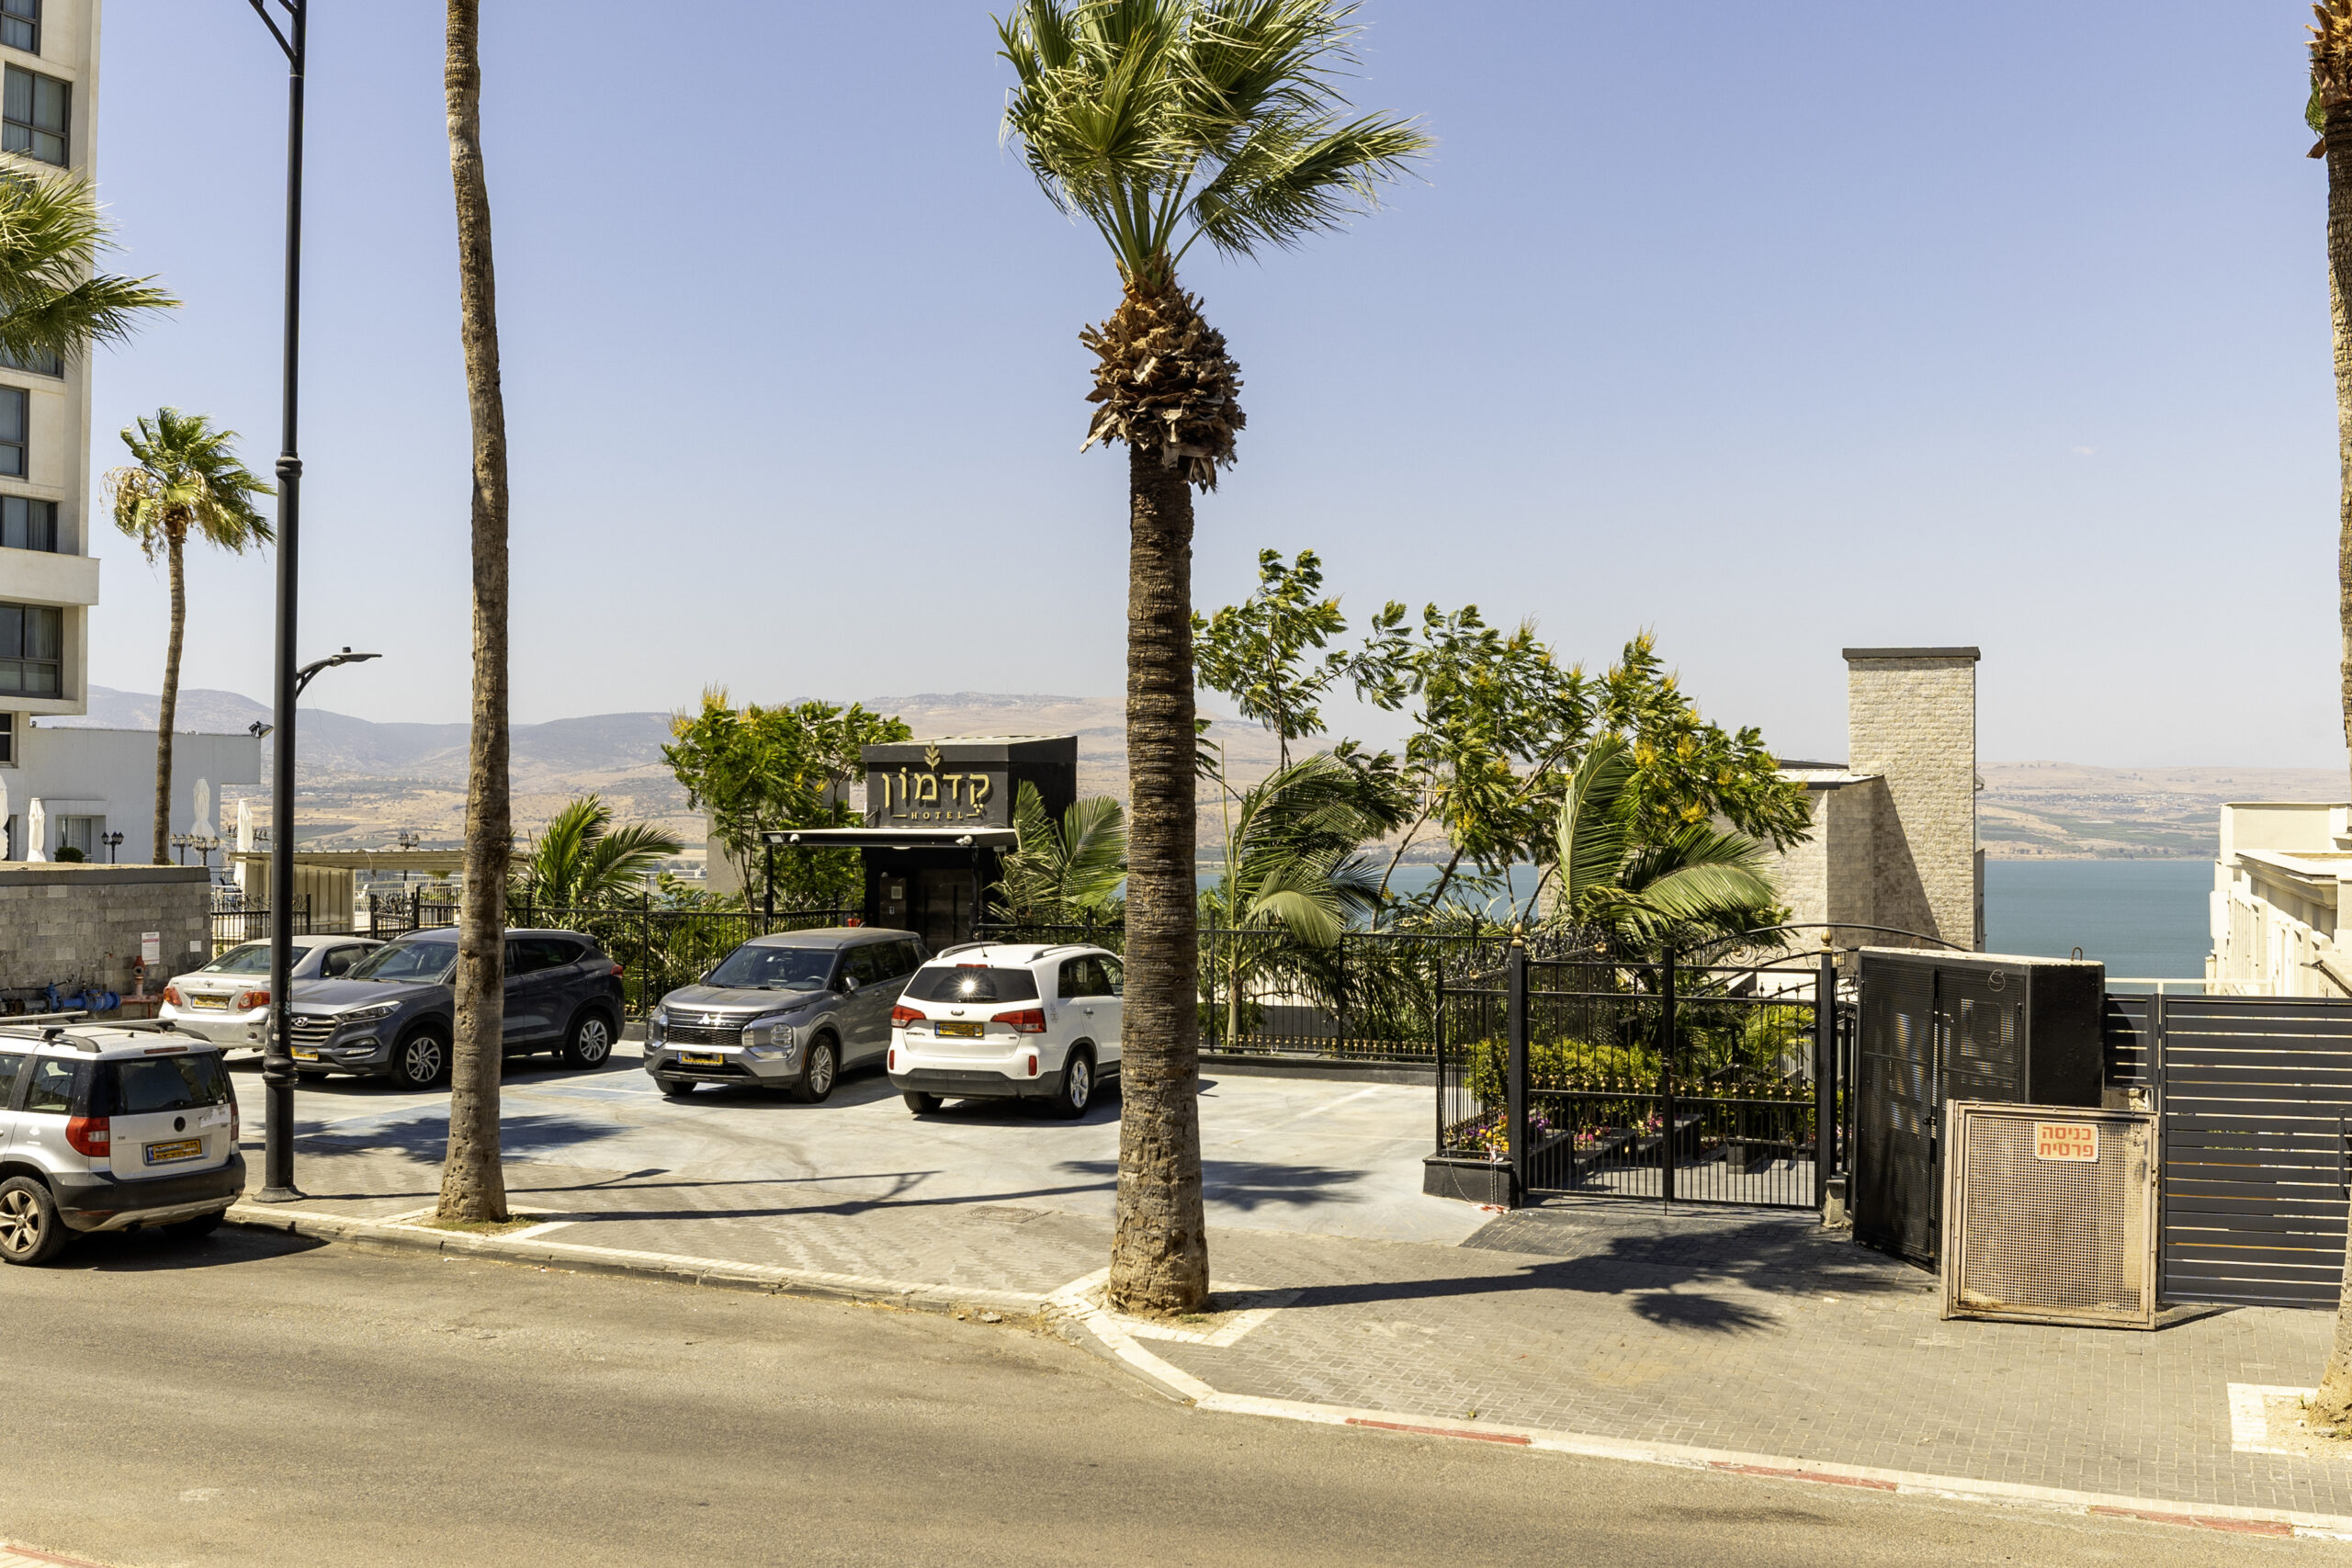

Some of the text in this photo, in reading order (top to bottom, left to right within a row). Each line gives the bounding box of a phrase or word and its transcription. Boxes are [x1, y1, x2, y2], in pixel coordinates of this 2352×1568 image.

[910, 811, 964, 819] HOTEL
[2042, 1126, 2091, 1141] כניסה
[2039, 1143, 2094, 1157] פרטית
